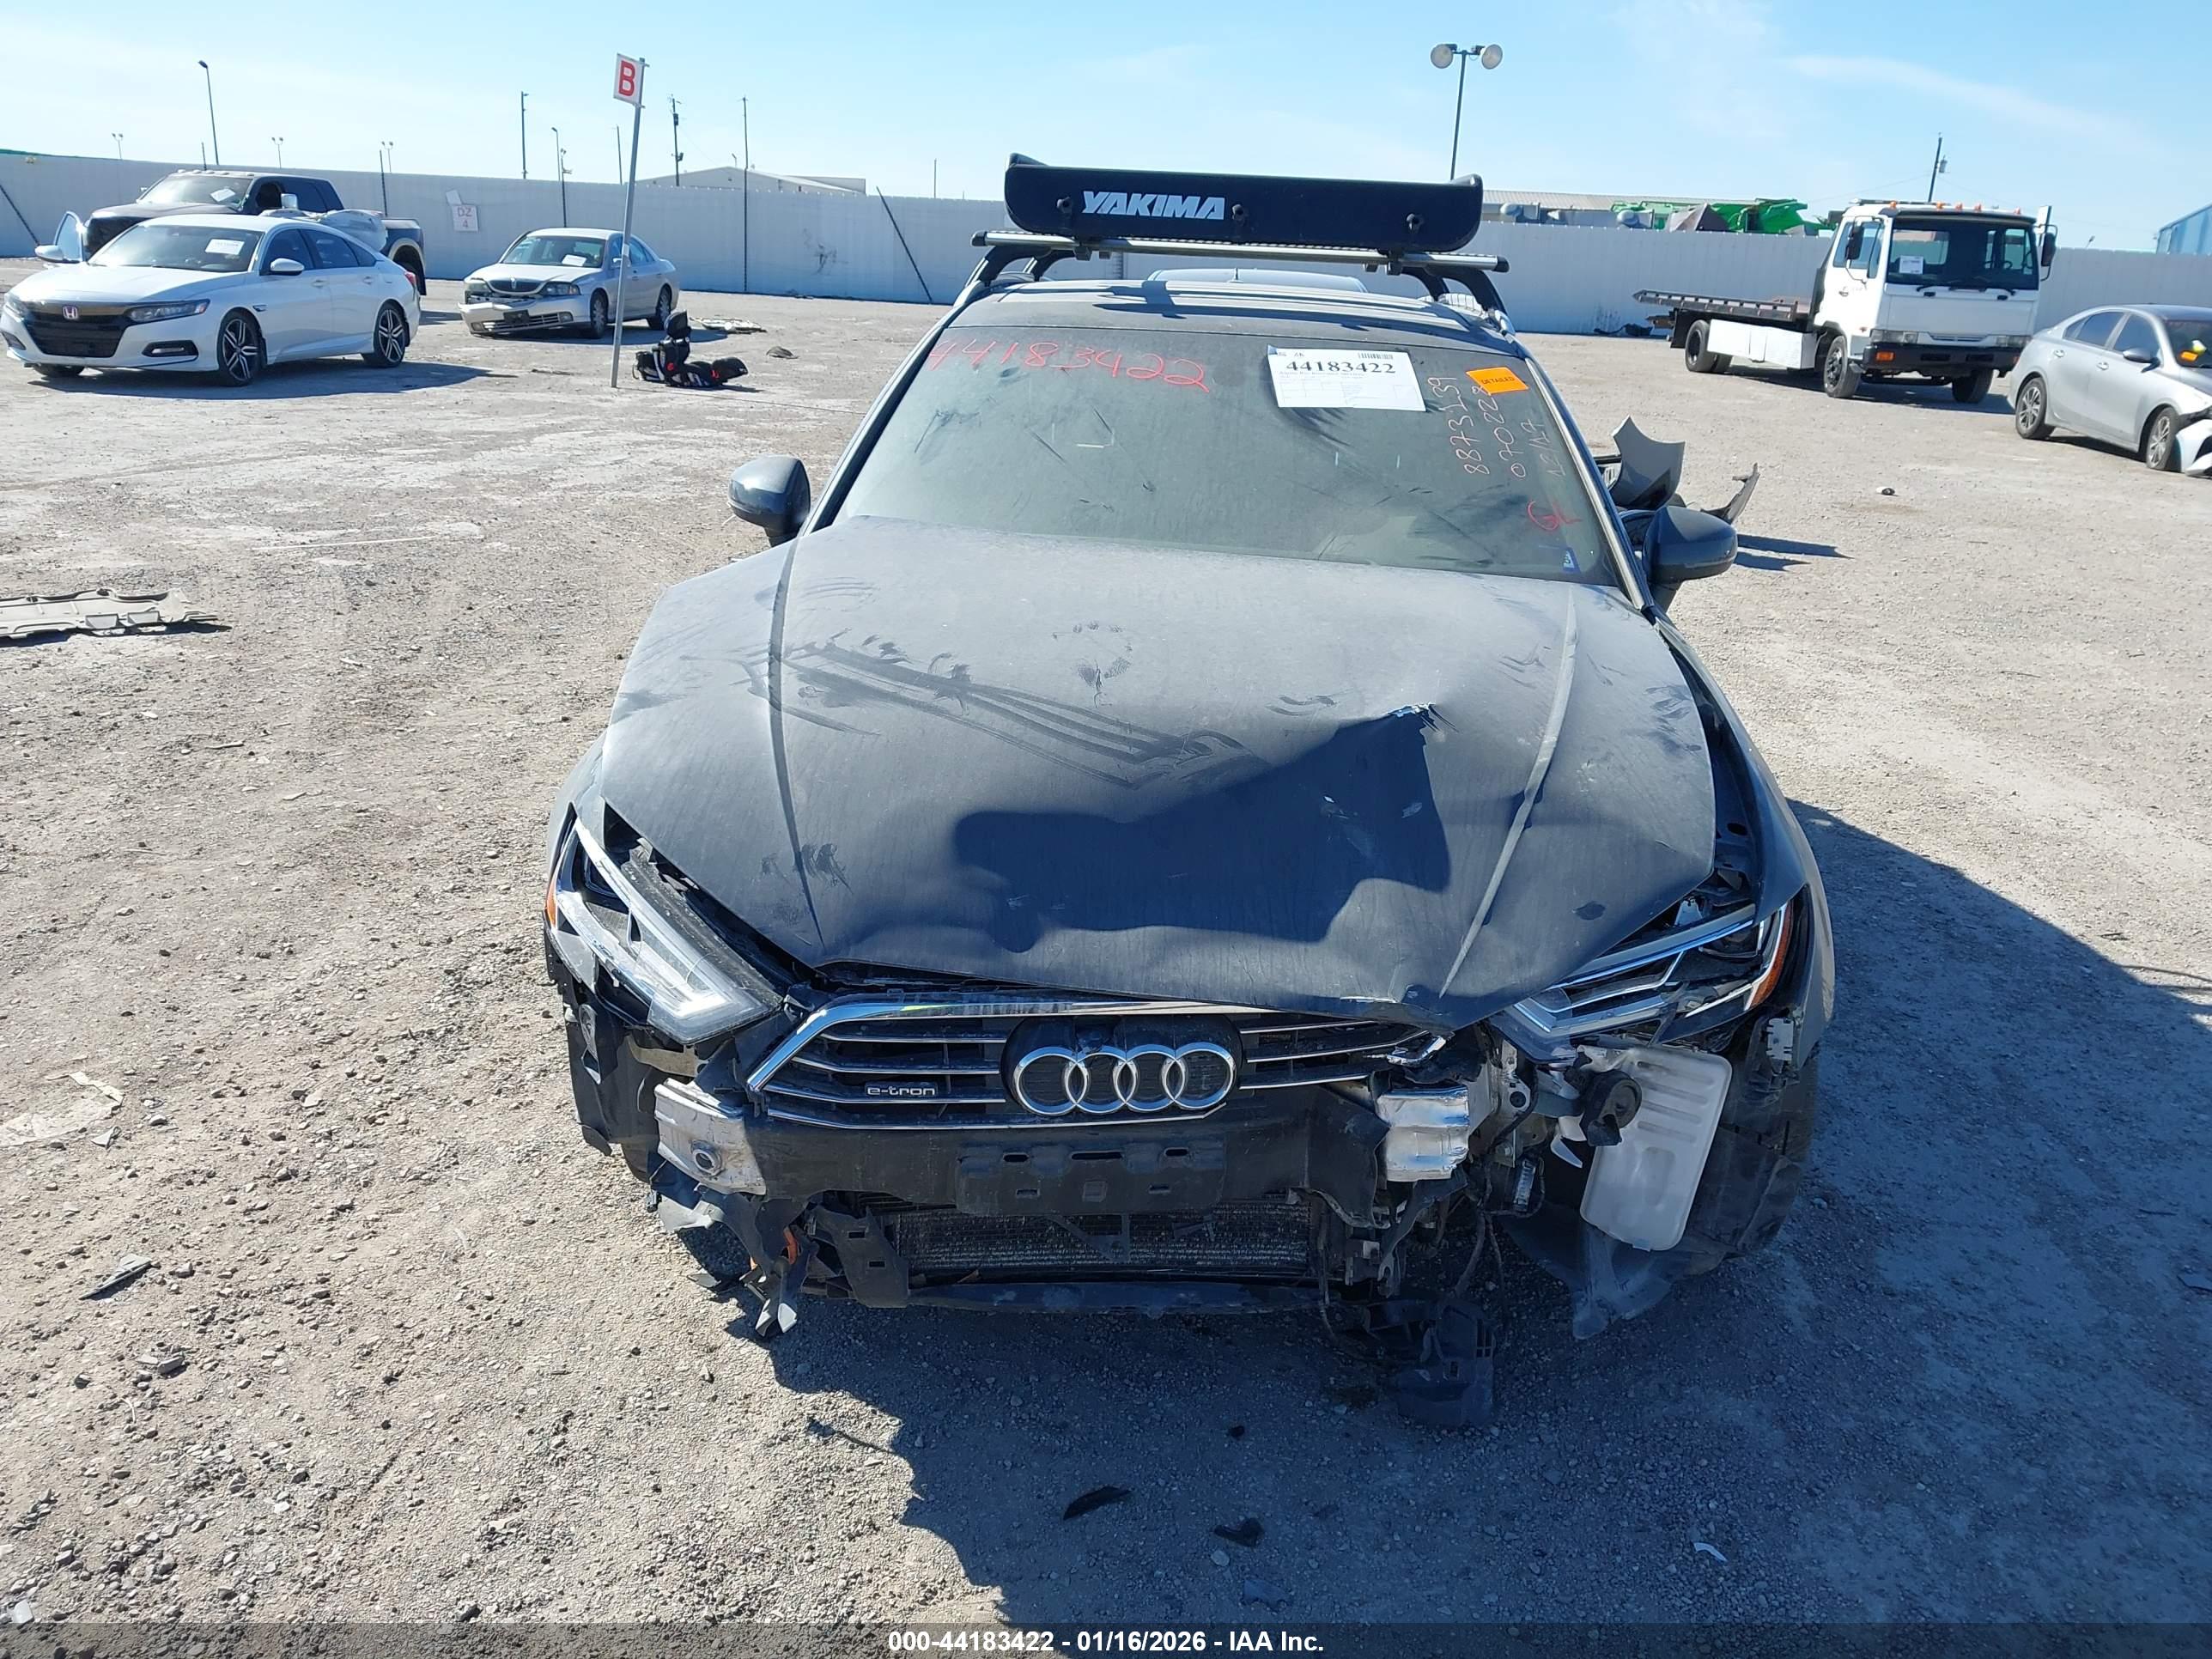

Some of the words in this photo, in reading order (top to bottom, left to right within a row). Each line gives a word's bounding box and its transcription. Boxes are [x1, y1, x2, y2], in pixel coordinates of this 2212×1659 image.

[618, 60, 635, 96] B
[1082, 191, 1225, 221] YAKIMA
[929, 338, 1210, 392] 44183422
[1286, 361, 1396, 374] 44183422
[1427, 376, 1491, 476] 8873139
[867, 1085, 935, 1096] e-tron
